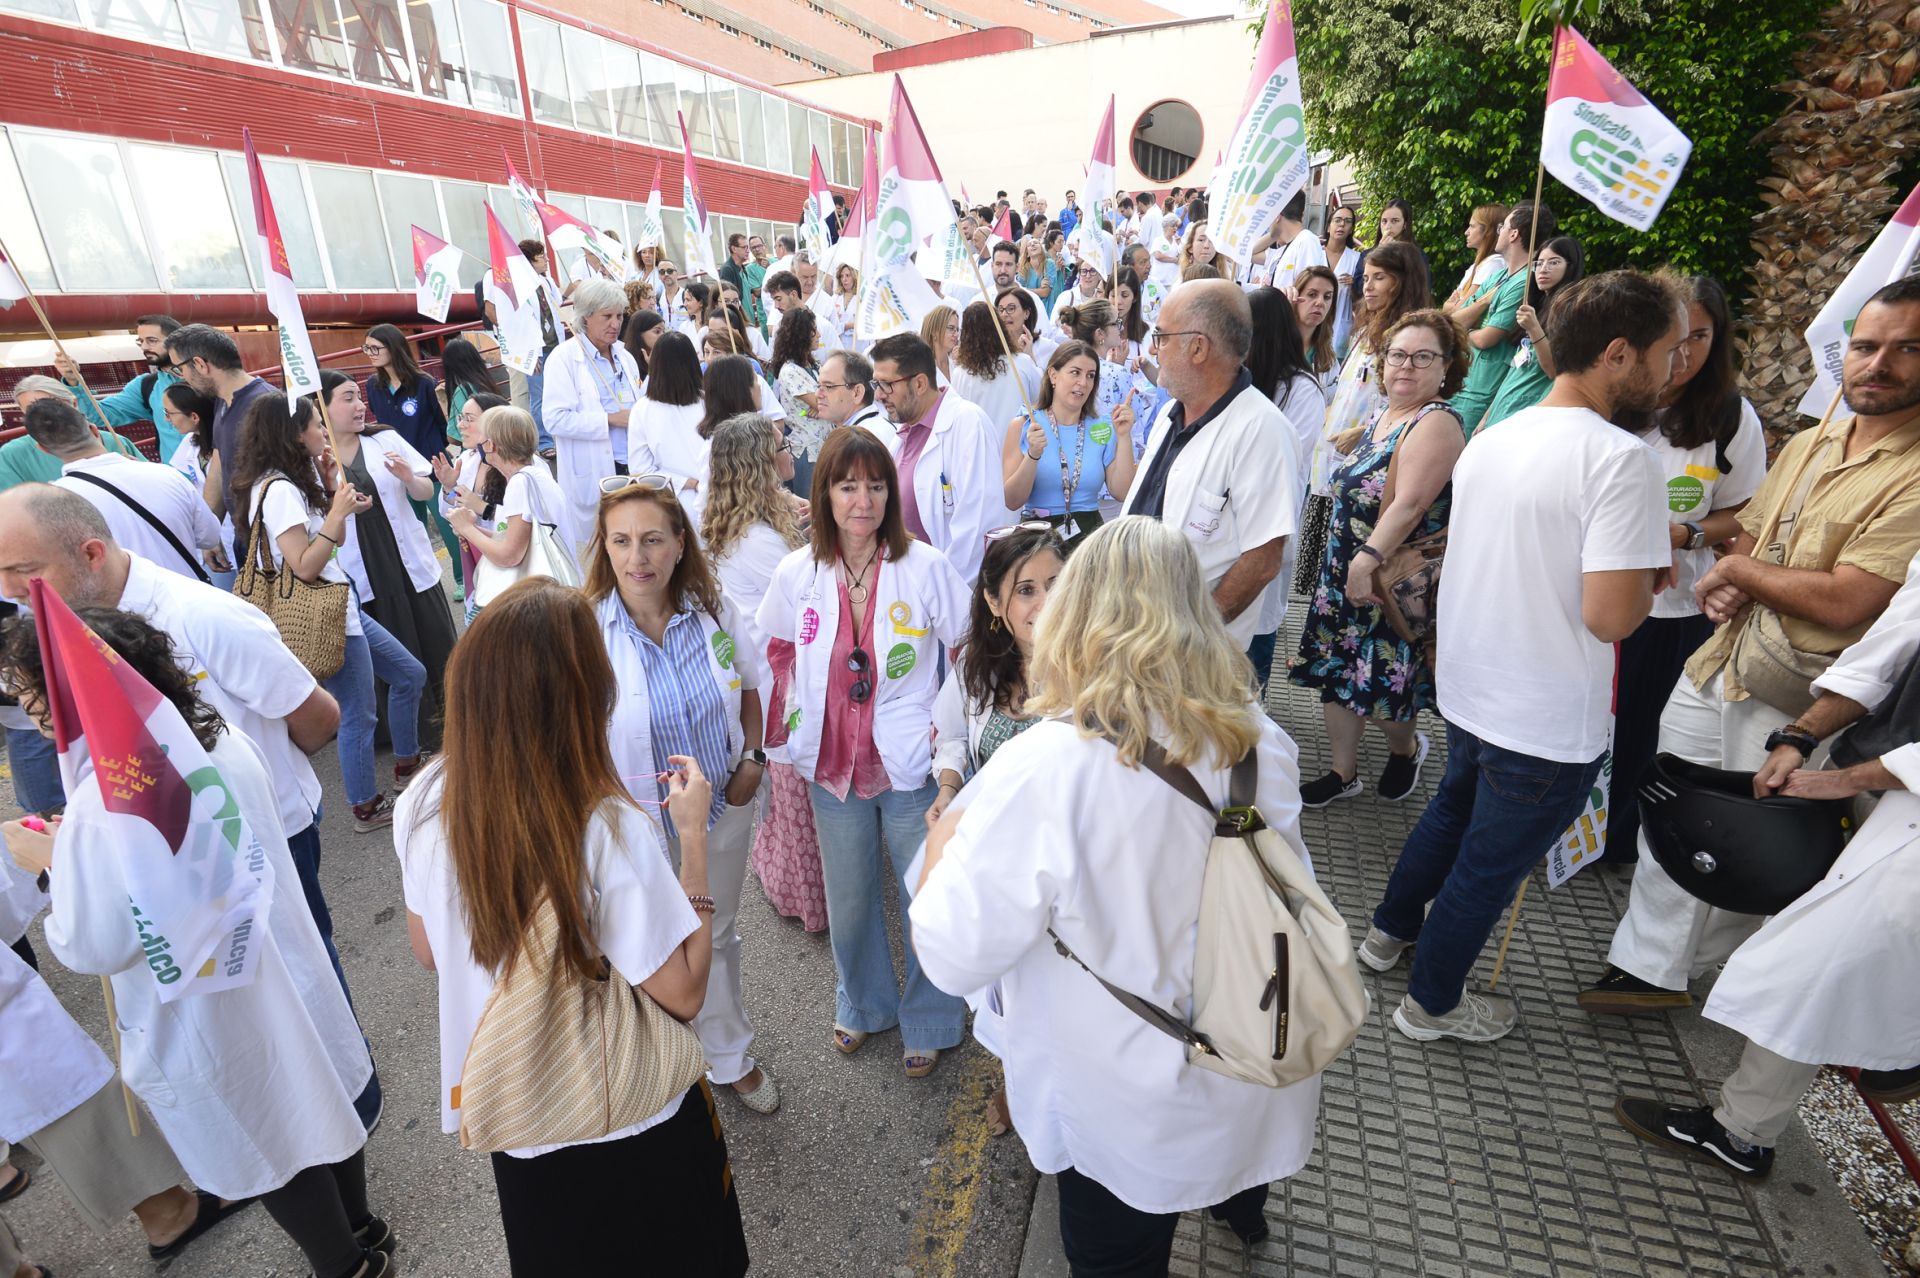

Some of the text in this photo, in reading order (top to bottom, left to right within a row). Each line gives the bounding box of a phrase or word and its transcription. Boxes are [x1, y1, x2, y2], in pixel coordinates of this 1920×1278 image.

[1573, 102, 1632, 142] Sindicato
[1569, 129, 1670, 208] CESM
[1609, 198, 1649, 223] Murcia
[279, 325, 311, 386] Médico
